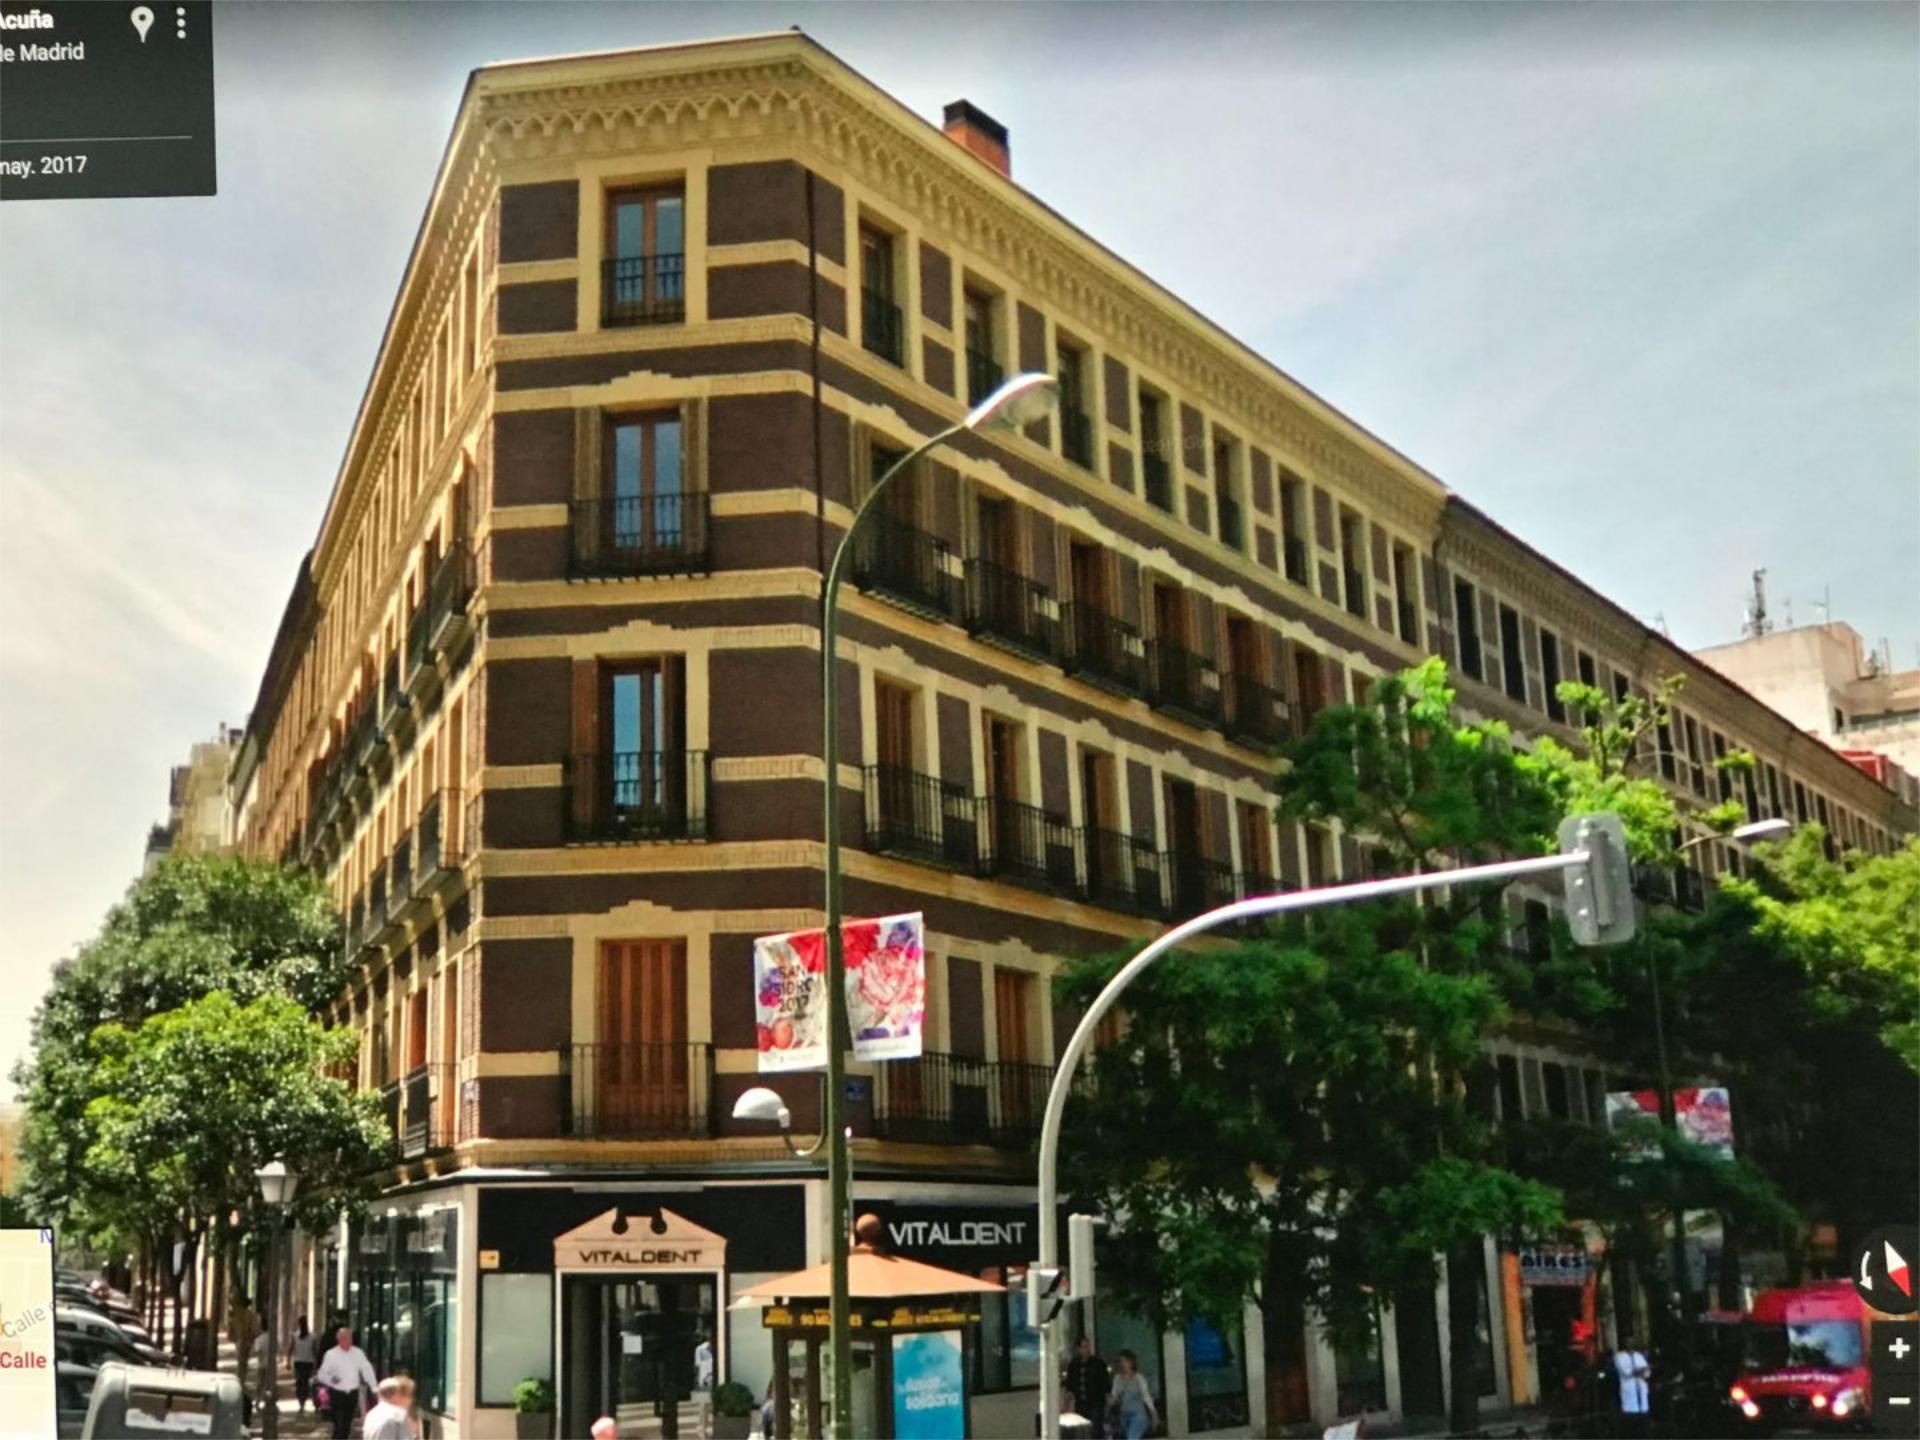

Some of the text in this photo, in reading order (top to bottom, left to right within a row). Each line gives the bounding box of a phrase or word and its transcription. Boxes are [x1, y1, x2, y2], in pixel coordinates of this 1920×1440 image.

[19, 41, 85, 62] Madrid
[40, 155, 88, 175] 2017
[888, 1221, 1027, 1246] VITALDENT
[578, 1249, 703, 1264] VITALDENT
[2, 1307, 46, 1339] Calle
[0, 1351, 47, 1369] Calle
